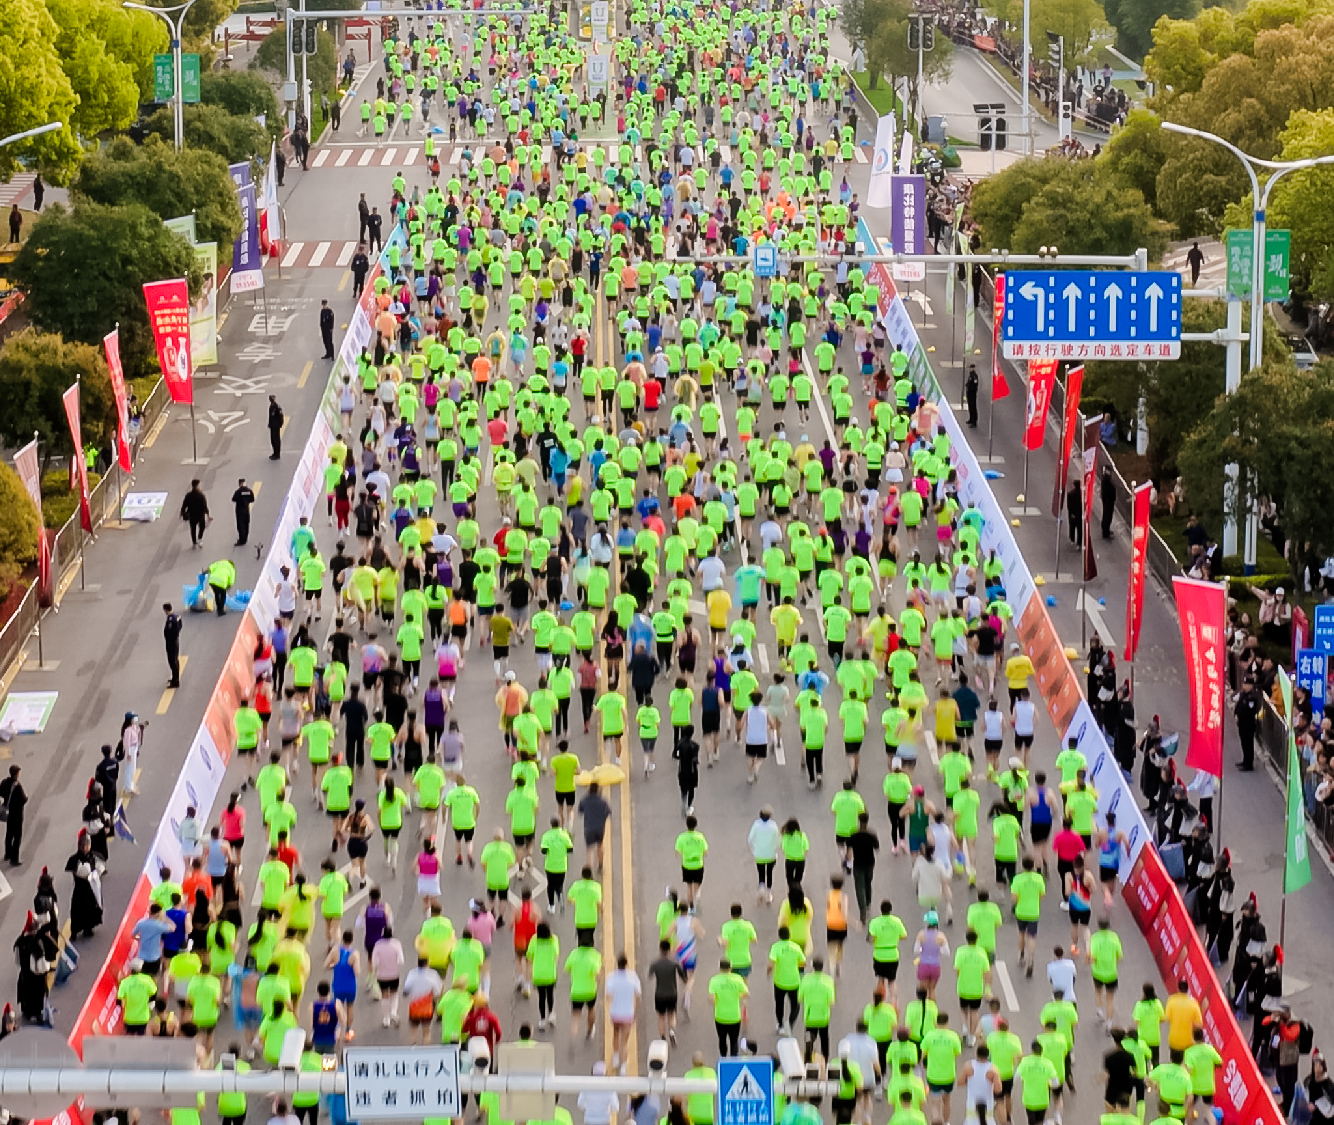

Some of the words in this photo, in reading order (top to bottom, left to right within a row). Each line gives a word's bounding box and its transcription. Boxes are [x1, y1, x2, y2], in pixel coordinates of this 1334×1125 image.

[1012, 343, 1171, 357] 请按行驶方向选定车道
[1300, 656, 1323, 674] 右转
[355, 1088, 453, 1107] 违者抓拍
